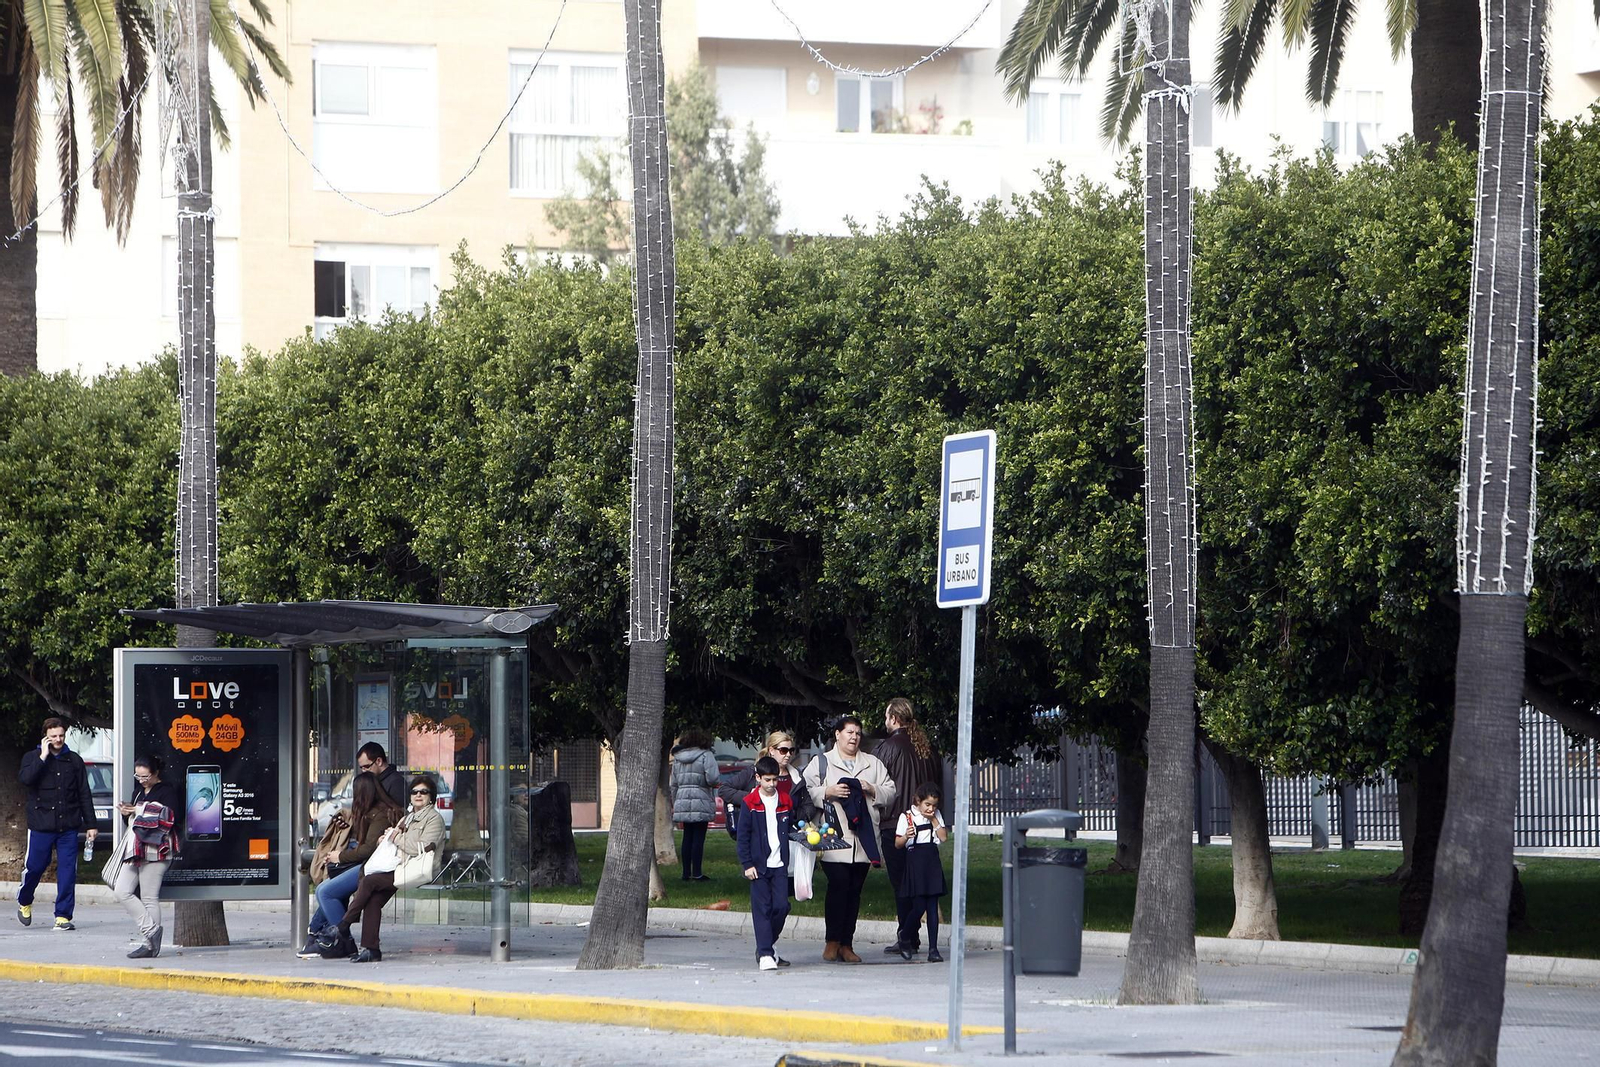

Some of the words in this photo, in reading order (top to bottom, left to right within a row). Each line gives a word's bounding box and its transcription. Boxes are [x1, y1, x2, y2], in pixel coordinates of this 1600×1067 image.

[955, 552, 970, 565] BUS
[946, 568, 977, 583] URBANO
[191, 654, 223, 662] JCDecaux
[173, 676, 240, 700] Love
[176, 723, 199, 731] Fibra
[216, 723, 238, 731] Móvil
[215, 731, 238, 740] 24GB
